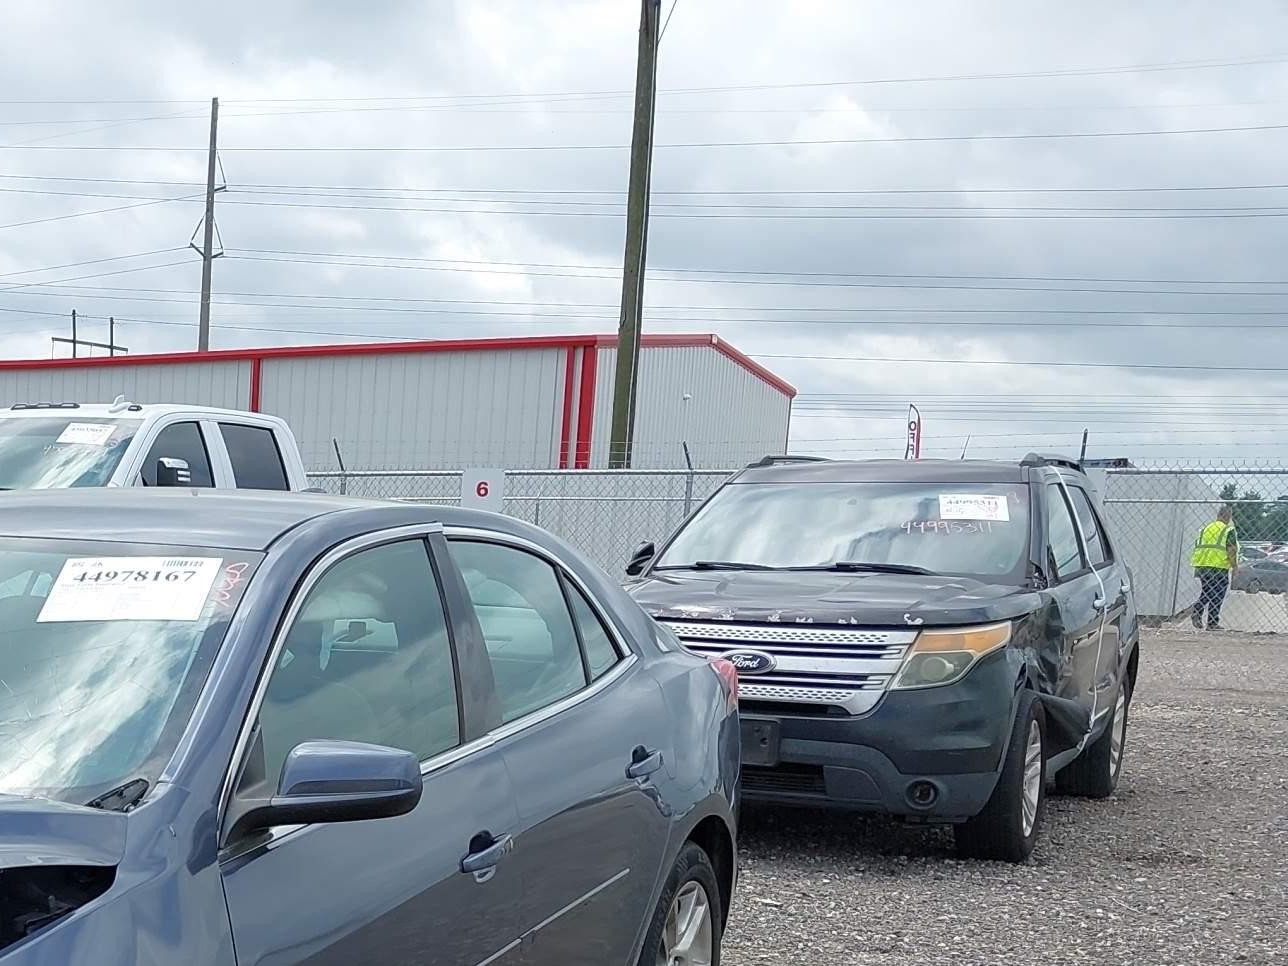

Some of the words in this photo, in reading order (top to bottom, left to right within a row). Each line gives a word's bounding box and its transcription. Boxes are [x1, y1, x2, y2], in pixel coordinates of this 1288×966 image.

[476, 481, 488, 497] 6
[900, 520, 992, 535] 44995311
[73, 570, 197, 583] 44978167
[732, 654, 761, 668] Ford
